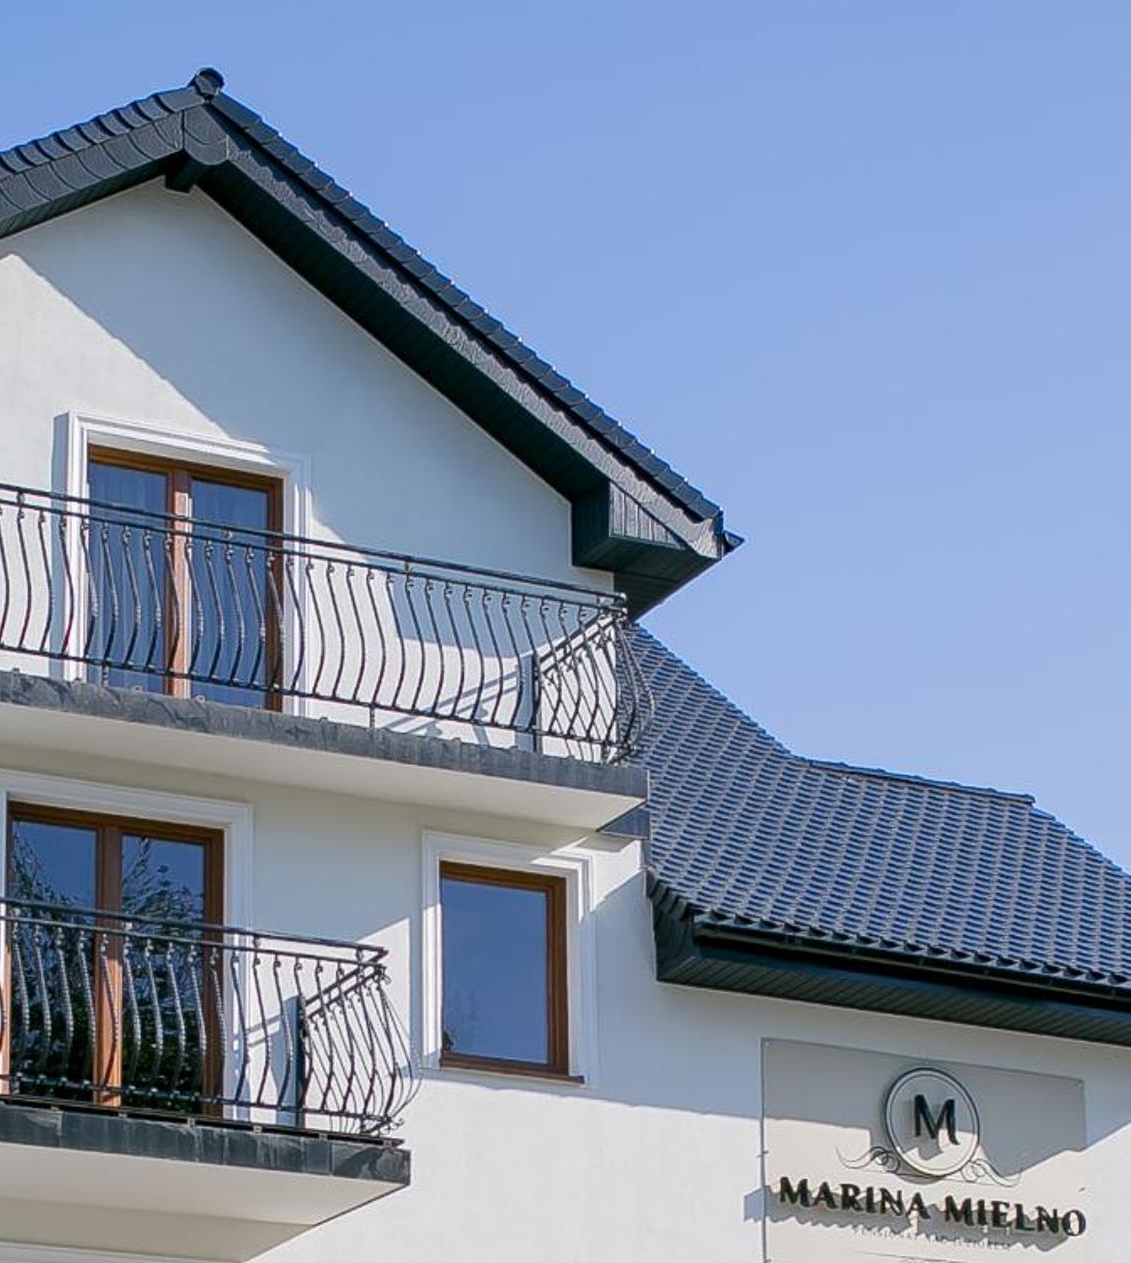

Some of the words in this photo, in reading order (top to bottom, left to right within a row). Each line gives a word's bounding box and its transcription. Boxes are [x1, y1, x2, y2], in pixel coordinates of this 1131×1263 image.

[913, 1094, 961, 1146] M
[780, 1176, 931, 1219] MARINA
[944, 1195, 1086, 1236] MIELNO
